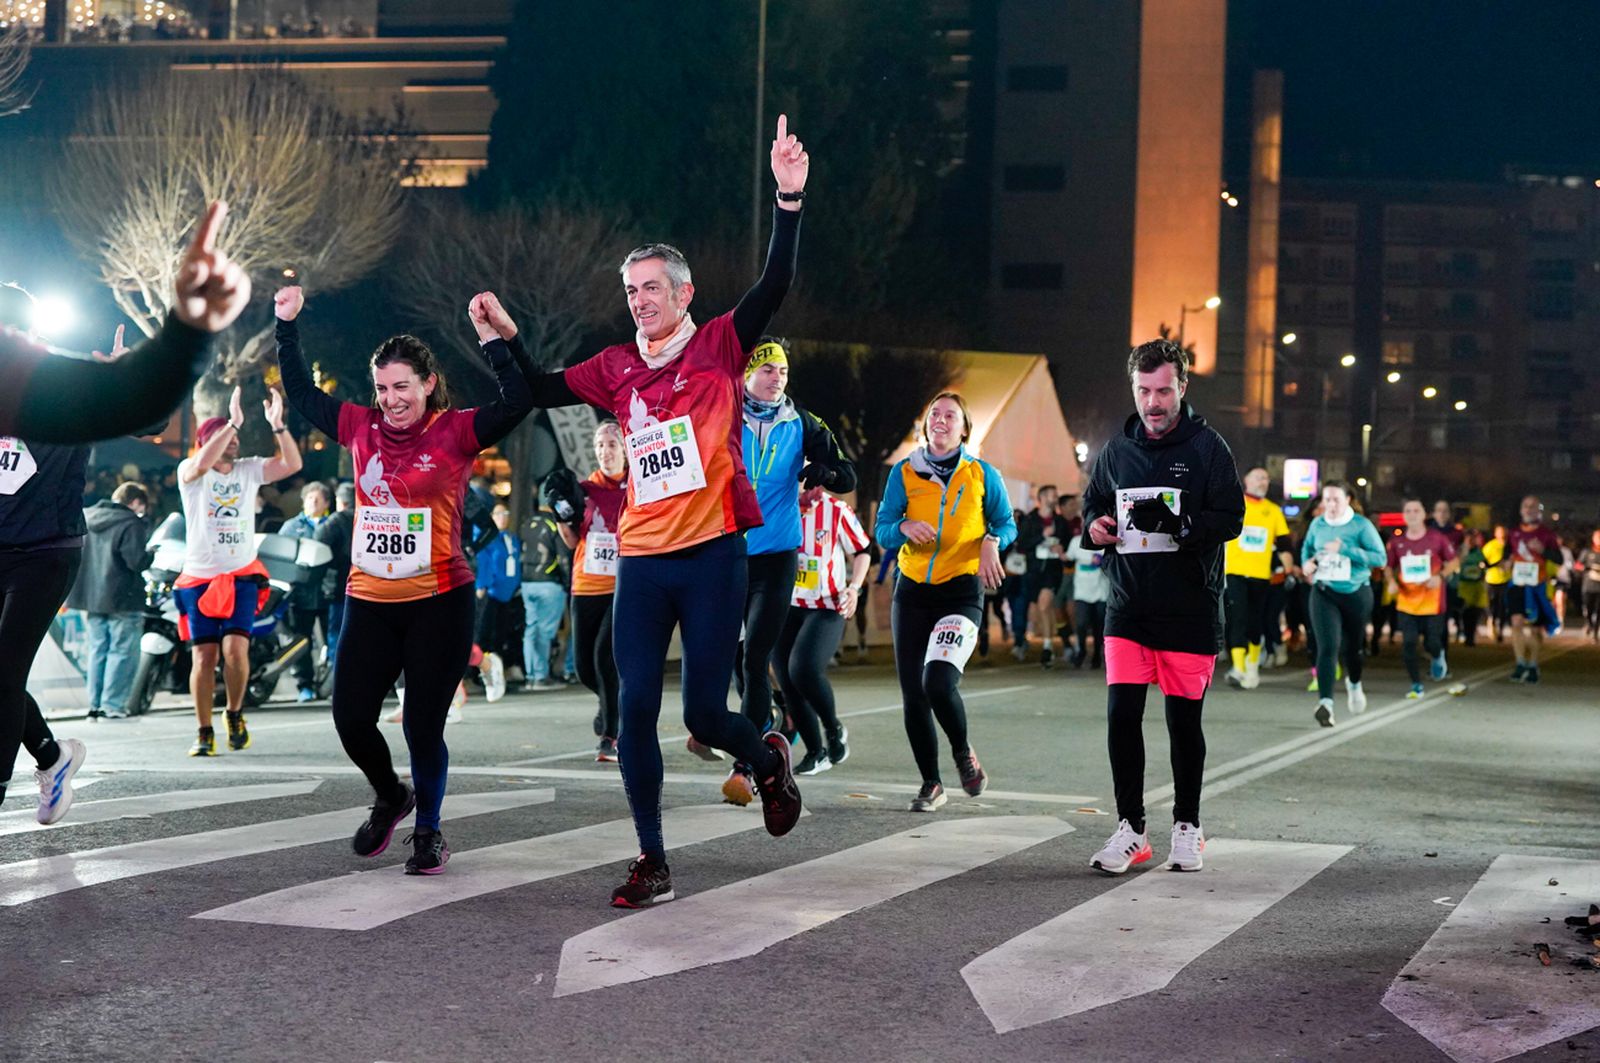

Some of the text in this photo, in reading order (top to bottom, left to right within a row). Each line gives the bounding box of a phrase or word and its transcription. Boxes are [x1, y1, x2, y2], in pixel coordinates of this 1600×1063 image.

[637, 435, 654, 446] NOCHE
[655, 431, 664, 440] DE
[633, 449, 644, 459] SAN
[639, 445, 685, 479] 2849
[371, 486, 390, 504] 43
[362, 522, 375, 531] SAN
[391, 515, 401, 524] DE
[365, 532, 416, 555] 2386
[936, 631, 964, 648] 994
